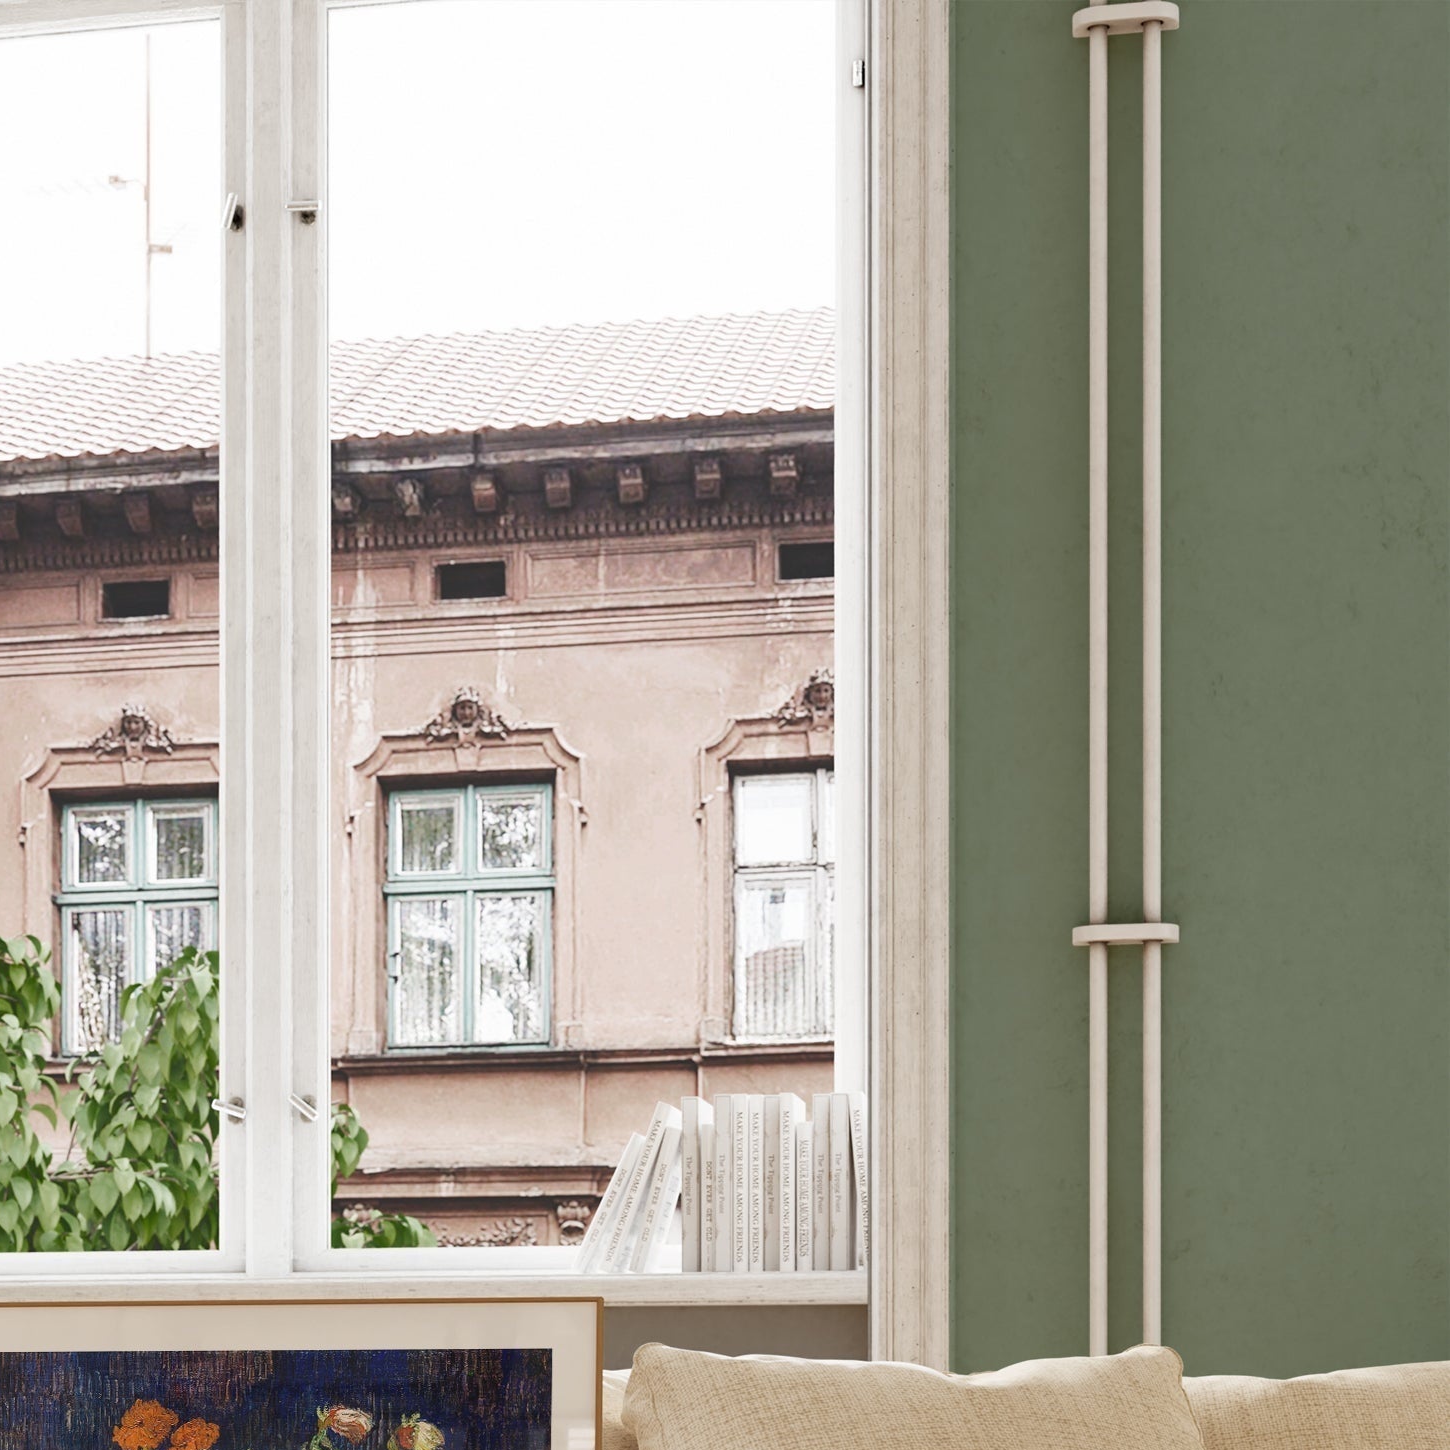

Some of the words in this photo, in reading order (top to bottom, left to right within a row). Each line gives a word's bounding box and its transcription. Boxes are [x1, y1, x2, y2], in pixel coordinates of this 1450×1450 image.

[649, 1119, 662, 1142] MAKE
[736, 1111, 744, 1135] MAKE
[752, 1112, 760, 1136] MAKE
[782, 1110, 790, 1135] MAKE
[852, 1109, 862, 1133] MAKE
[639, 1143, 653, 1168] YOUR
[736, 1137, 744, 1162] YOUR
[752, 1137, 760, 1162] YOUR
[782, 1136, 790, 1161] YOUR
[799, 1139, 809, 1159] MAKE
[855, 1135, 864, 1160] YOUR
[630, 1168, 644, 1194] HOME
[736, 1163, 744, 1190] HOME
[752, 1164, 760, 1190] HOME
[782, 1162, 790, 1190] HOME
[799, 1160, 809, 1179] YOUR
[857, 1161, 866, 1188] HOME
[799, 1179, 809, 1201] HOME
[618, 1194, 634, 1227] AMONG
[736, 1191, 744, 1225] AMONG
[752, 1192, 760, 1226] AMONG
[782, 1190, 790, 1225] AMONG
[799, 1202, 809, 1228] AMONG
[606, 1226, 622, 1263] FRIENDS
[736, 1226, 744, 1263] FRIENDS
[752, 1226, 760, 1264] FRIENDS
[782, 1226, 790, 1263] FRIENDS
[799, 1228, 809, 1258] FRIENDS
